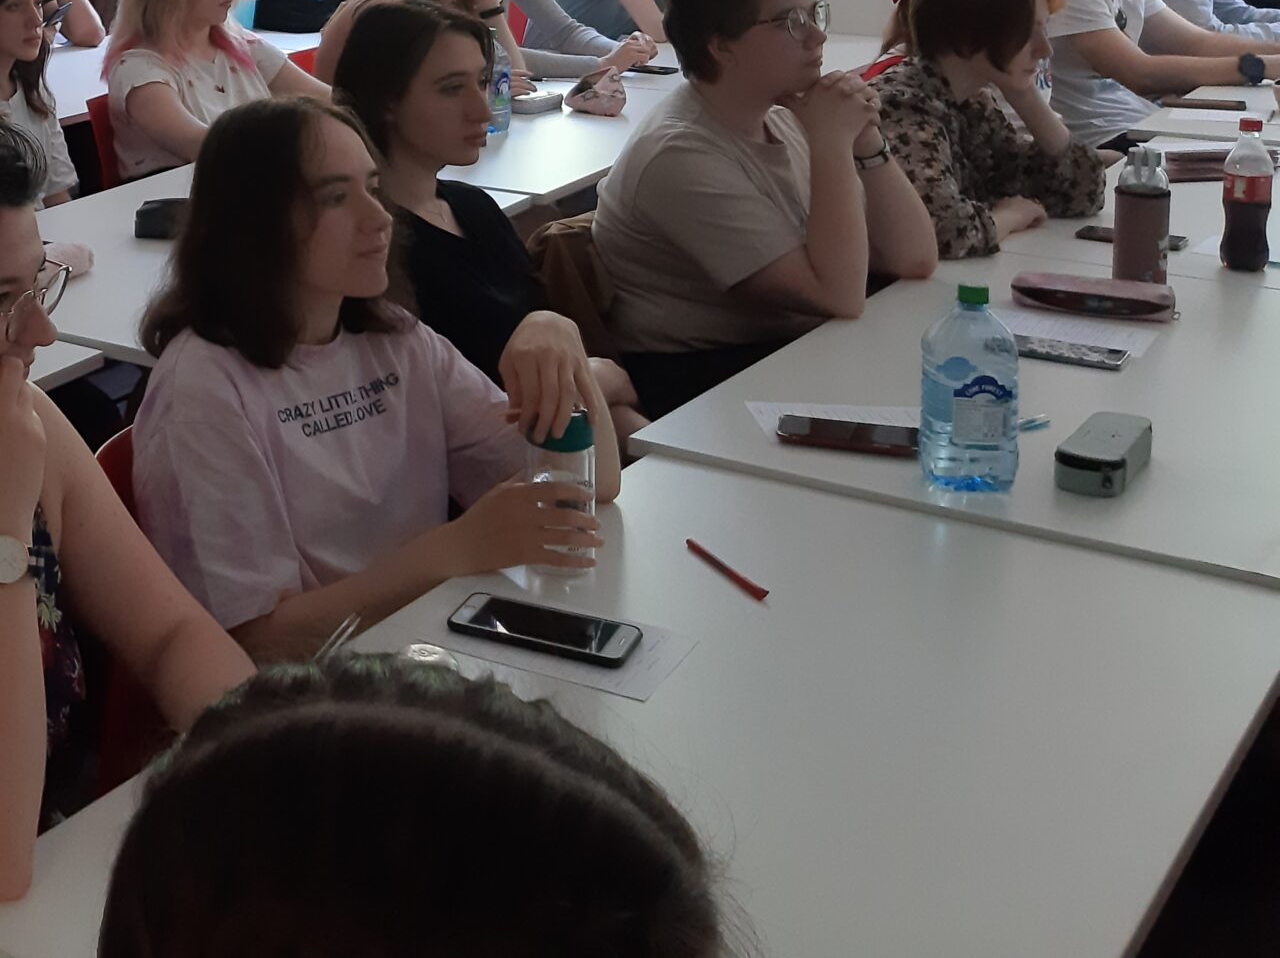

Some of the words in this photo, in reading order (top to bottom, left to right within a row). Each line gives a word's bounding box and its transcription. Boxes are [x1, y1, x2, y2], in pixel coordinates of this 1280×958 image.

[277, 400, 316, 423] CRAZY
[301, 411, 352, 437] CALLED
[353, 398, 387, 424] OVE
